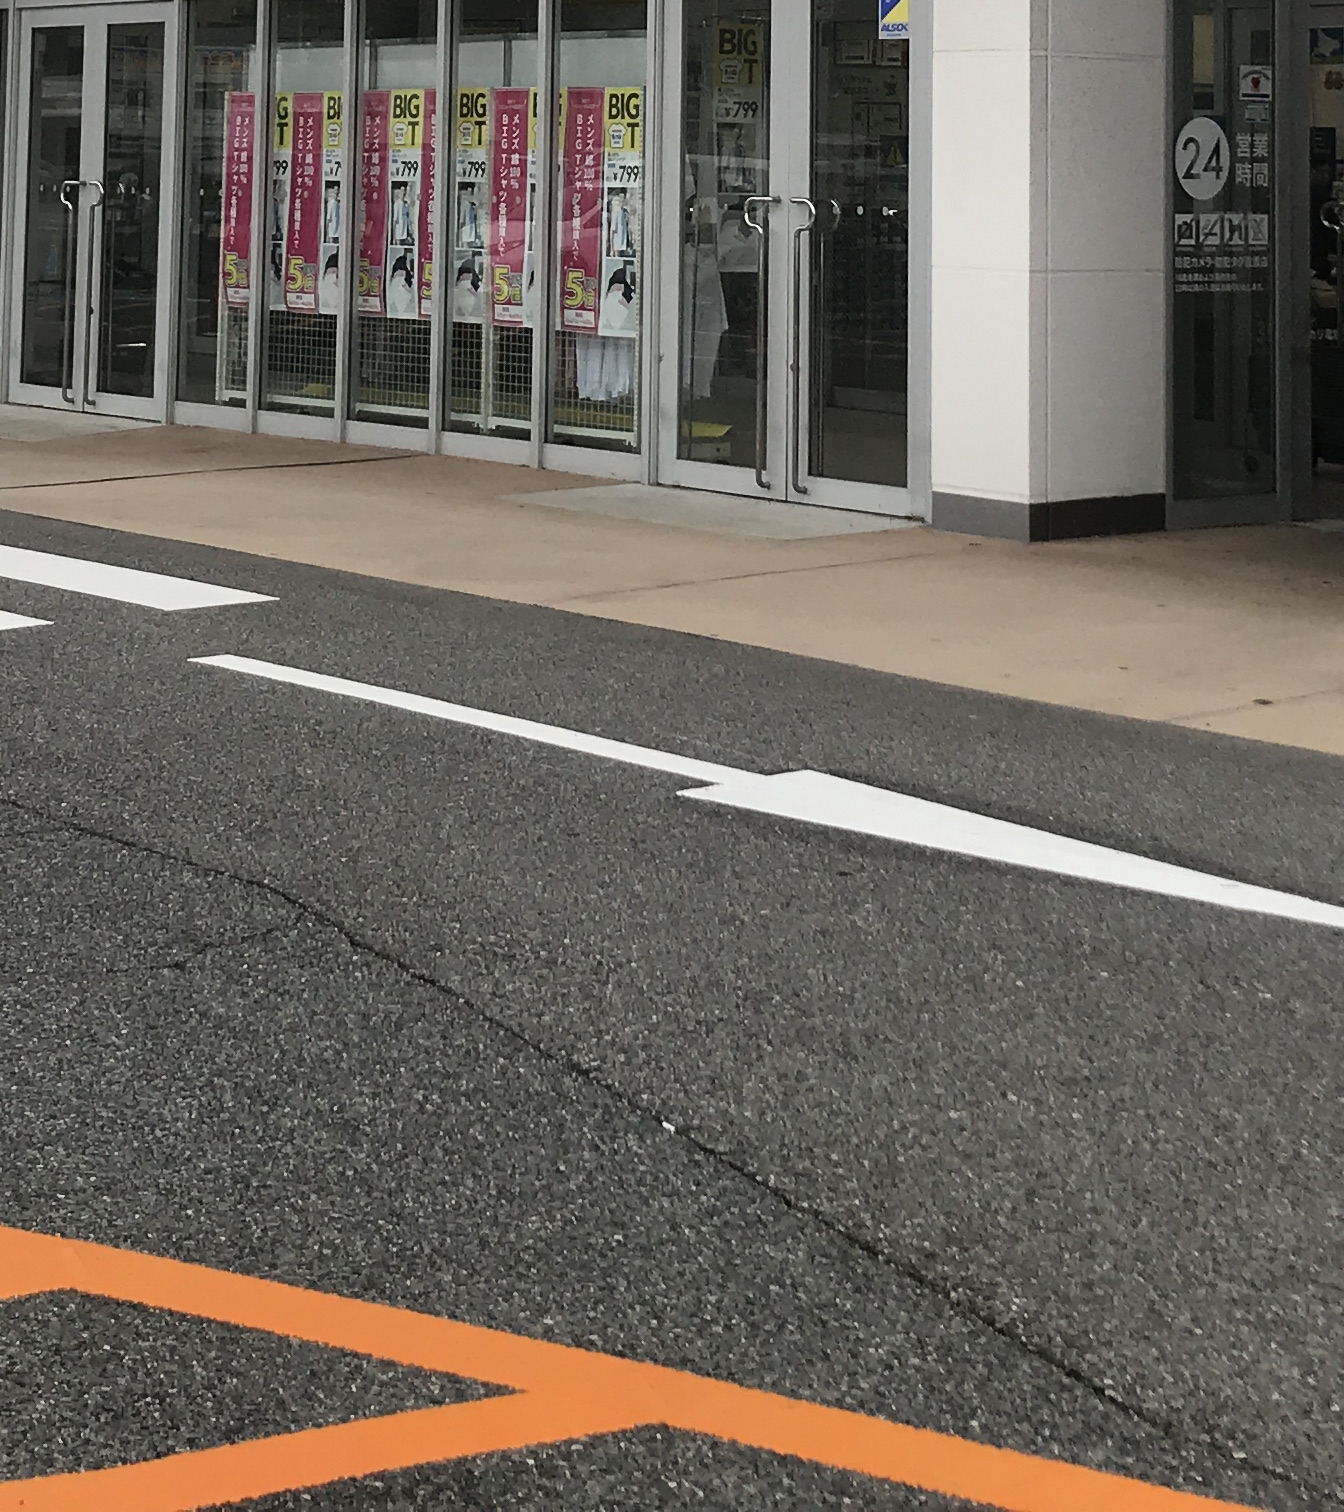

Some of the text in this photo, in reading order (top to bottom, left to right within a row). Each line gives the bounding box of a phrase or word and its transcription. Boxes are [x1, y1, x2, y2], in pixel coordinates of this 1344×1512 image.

[881, 23, 908, 32] ALSOK
[719, 28, 758, 55] BIG
[743, 59, 758, 84] T
[393, 94, 419, 119] BIG
[460, 93, 486, 118] BIG
[608, 92, 640, 120] BIG
[1181, 136, 1223, 180] 24
[1236, 133, 1268, 158] 営業
[1235, 162, 1268, 187] 時間
